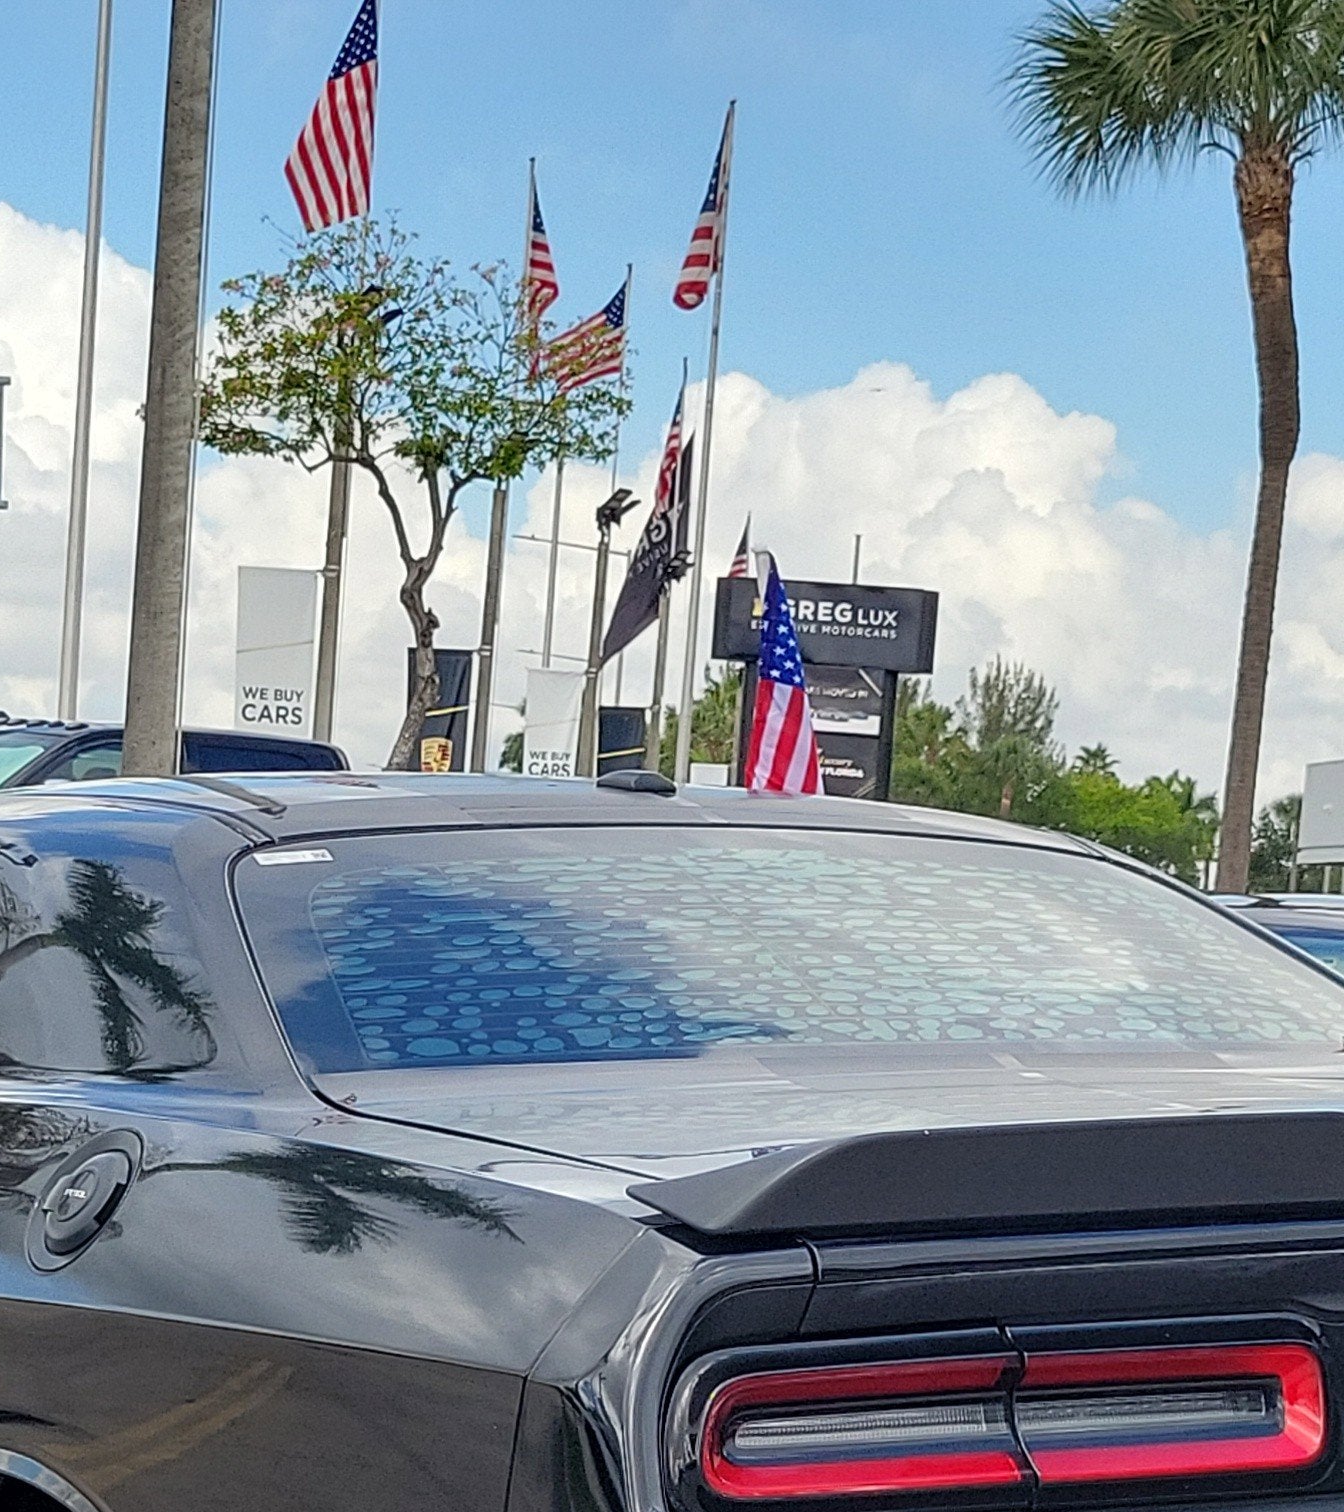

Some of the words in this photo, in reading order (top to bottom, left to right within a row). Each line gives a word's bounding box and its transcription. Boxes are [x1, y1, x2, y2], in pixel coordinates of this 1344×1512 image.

[857, 608, 899, 627] LUX
[822, 625, 898, 640] MOTORCARS
[242, 686, 269, 700] WE
[274, 688, 304, 702] BUY
[241, 703, 303, 725] CARS
[529, 751, 547, 761] WE
[550, 751, 571, 762] BUY
[528, 762, 571, 777] CARS
